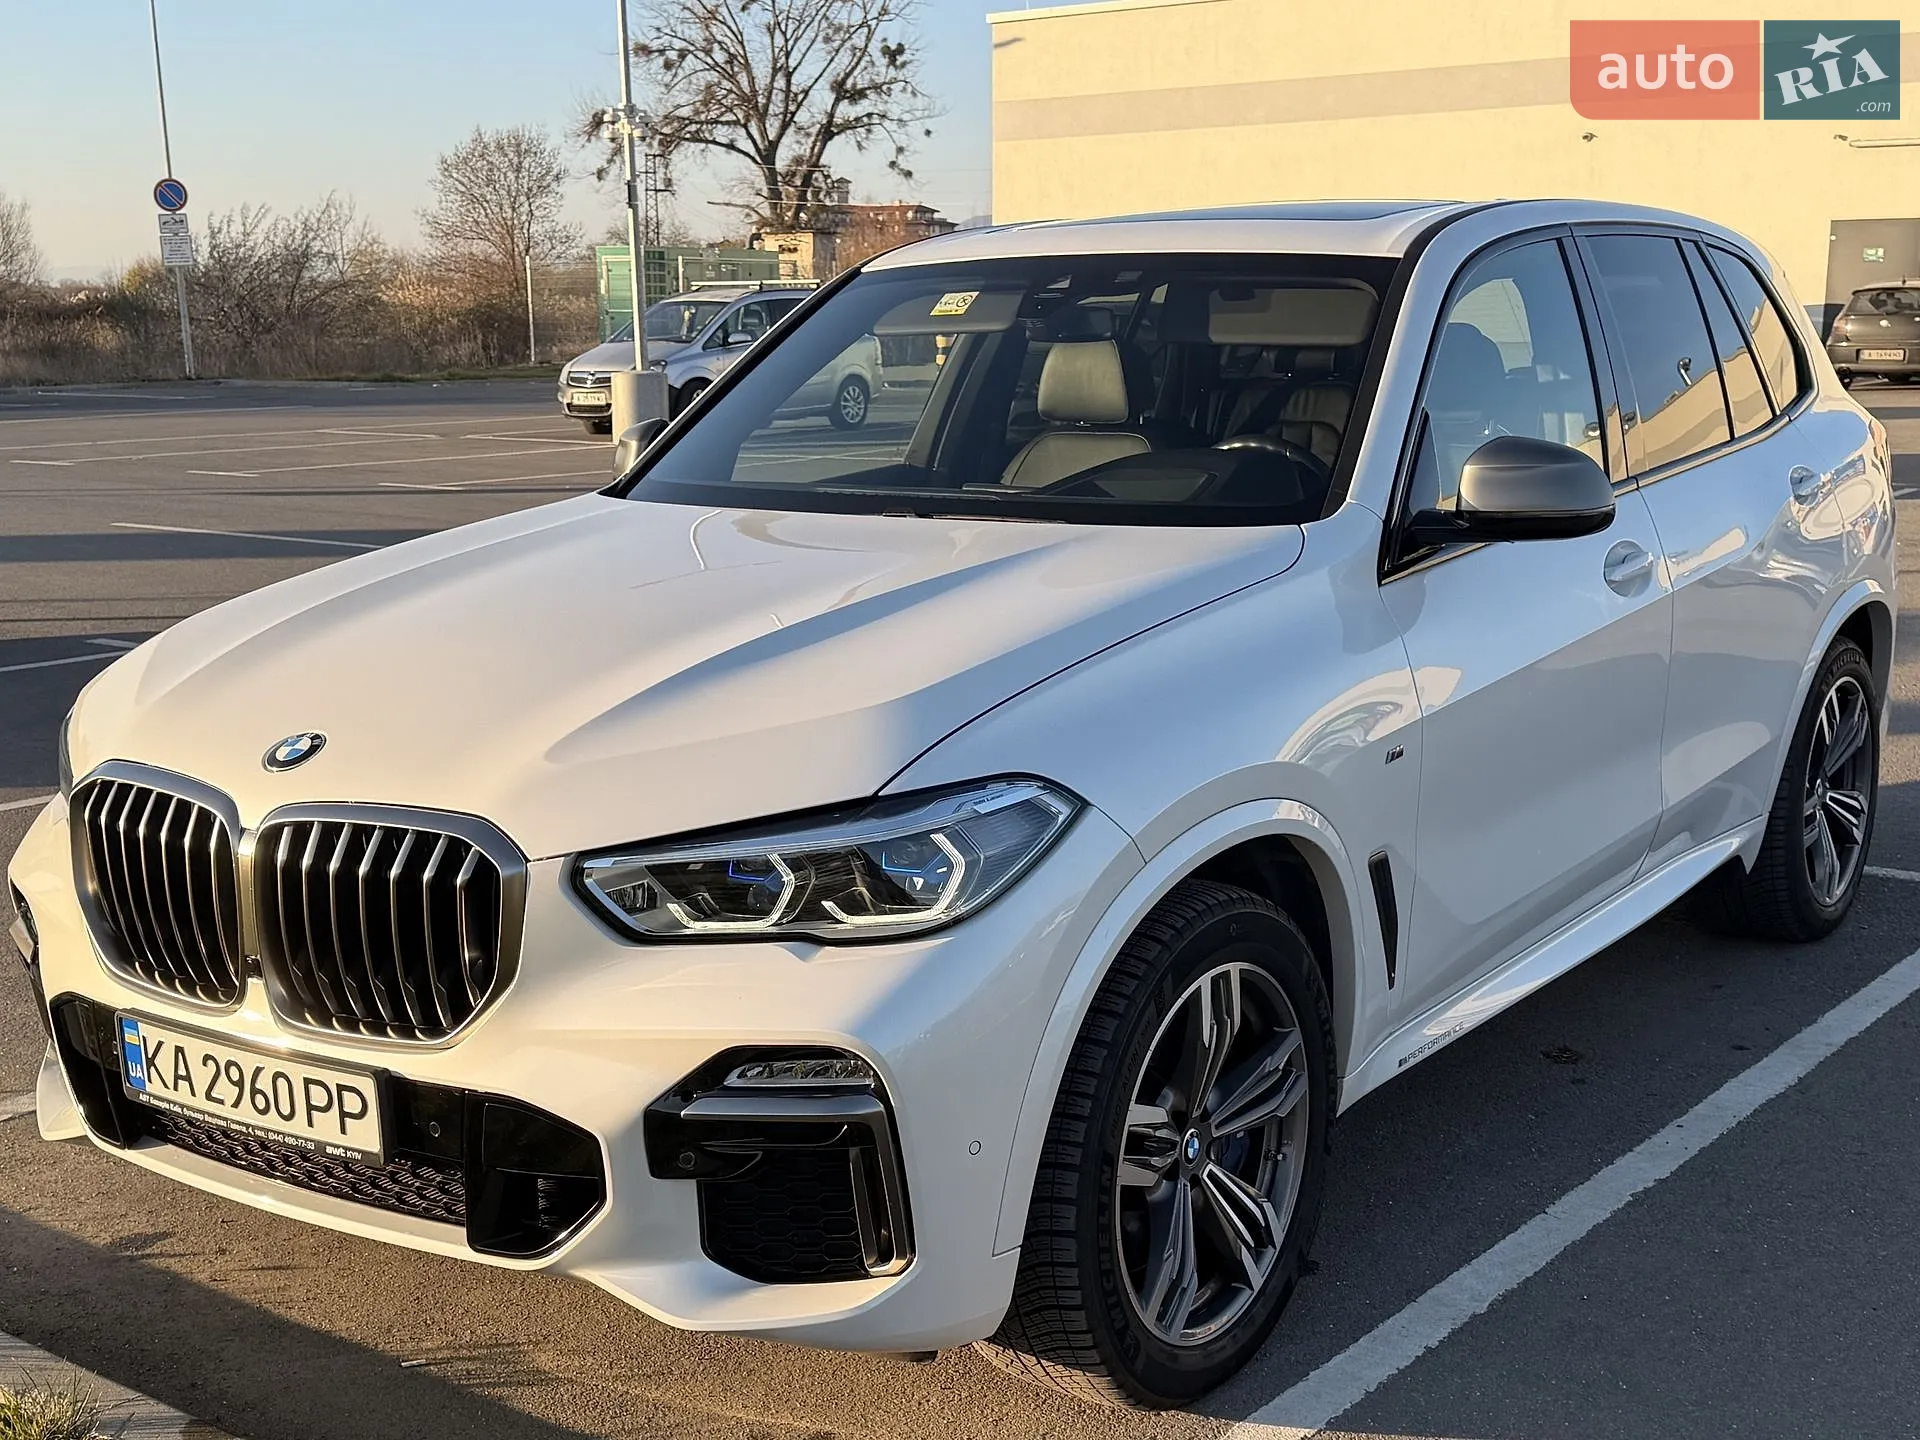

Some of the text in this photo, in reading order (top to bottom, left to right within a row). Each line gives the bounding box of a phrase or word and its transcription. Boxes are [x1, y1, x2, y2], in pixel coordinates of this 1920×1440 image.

[128, 1060, 145, 1080] UA
[142, 1035, 369, 1136] KA 2960 PP
[1098, 1165, 1126, 1331] MICHELIN
